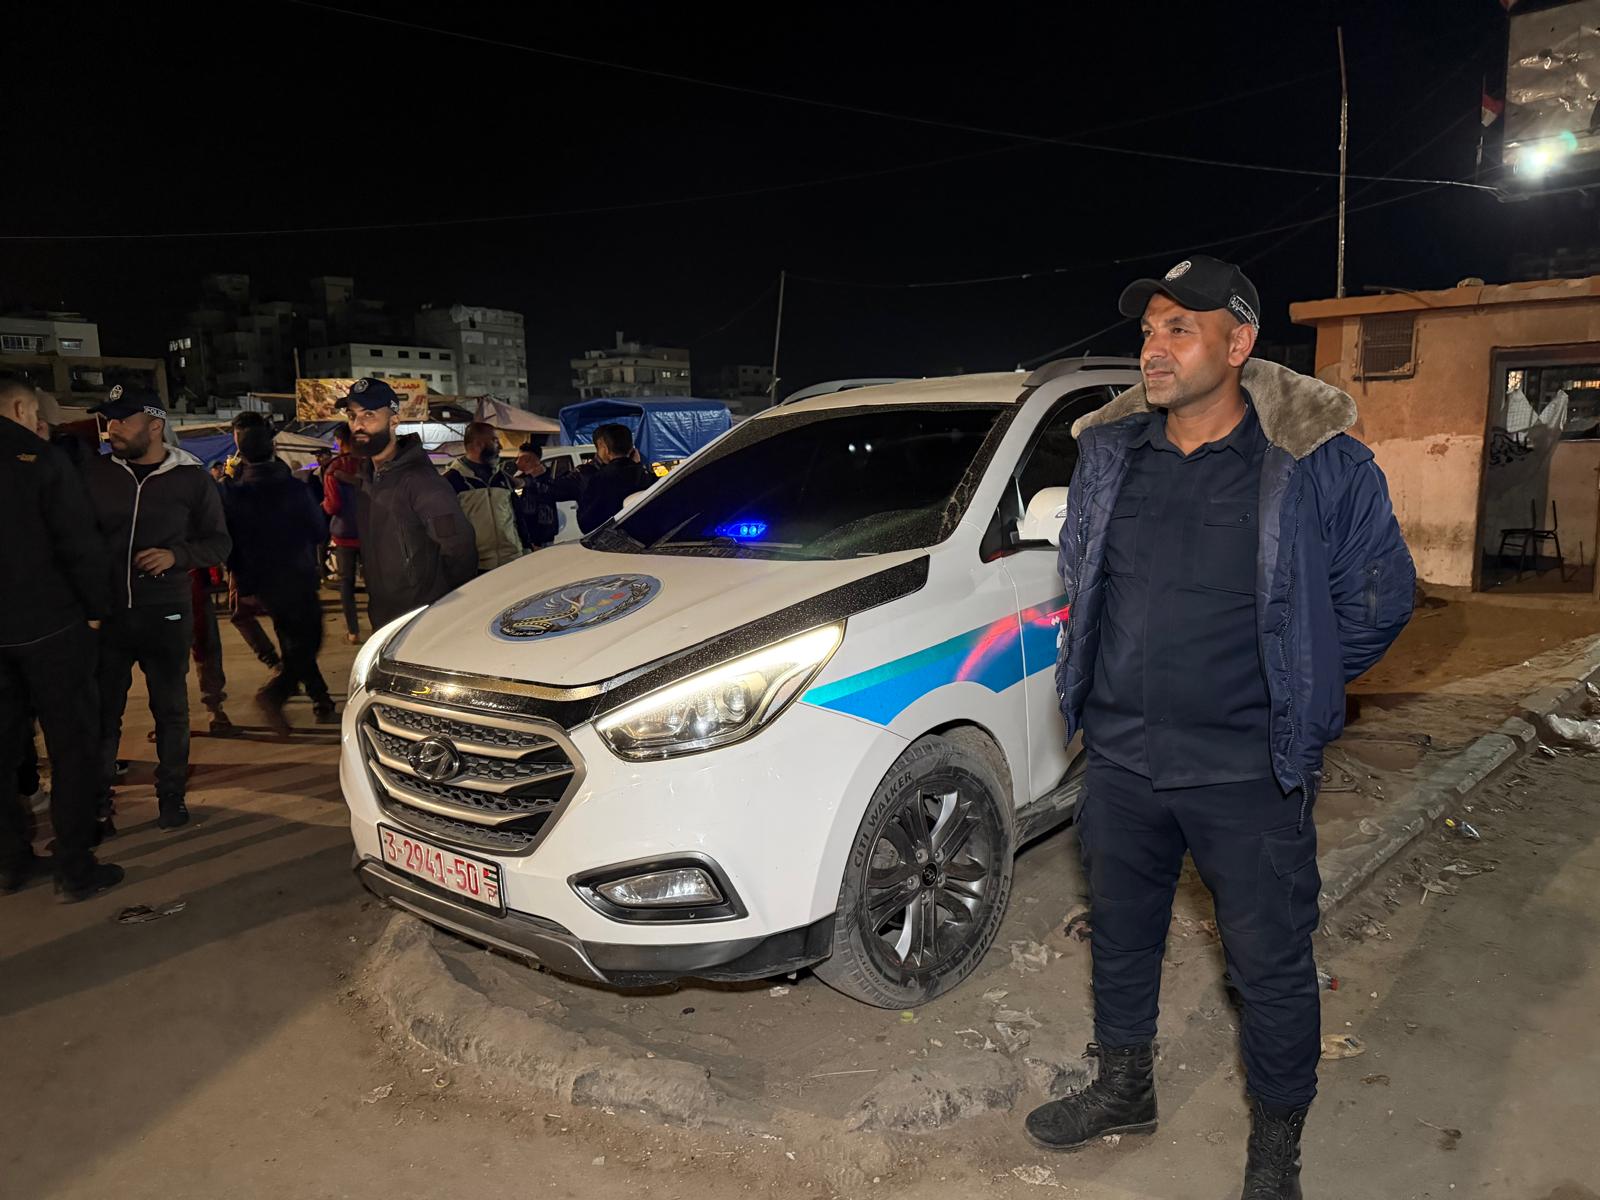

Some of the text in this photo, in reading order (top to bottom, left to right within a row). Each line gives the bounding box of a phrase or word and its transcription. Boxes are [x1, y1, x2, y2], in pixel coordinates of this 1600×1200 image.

[854, 770, 913, 868] CITI WALKER
[386, 832, 479, 896] 3-2941-50
